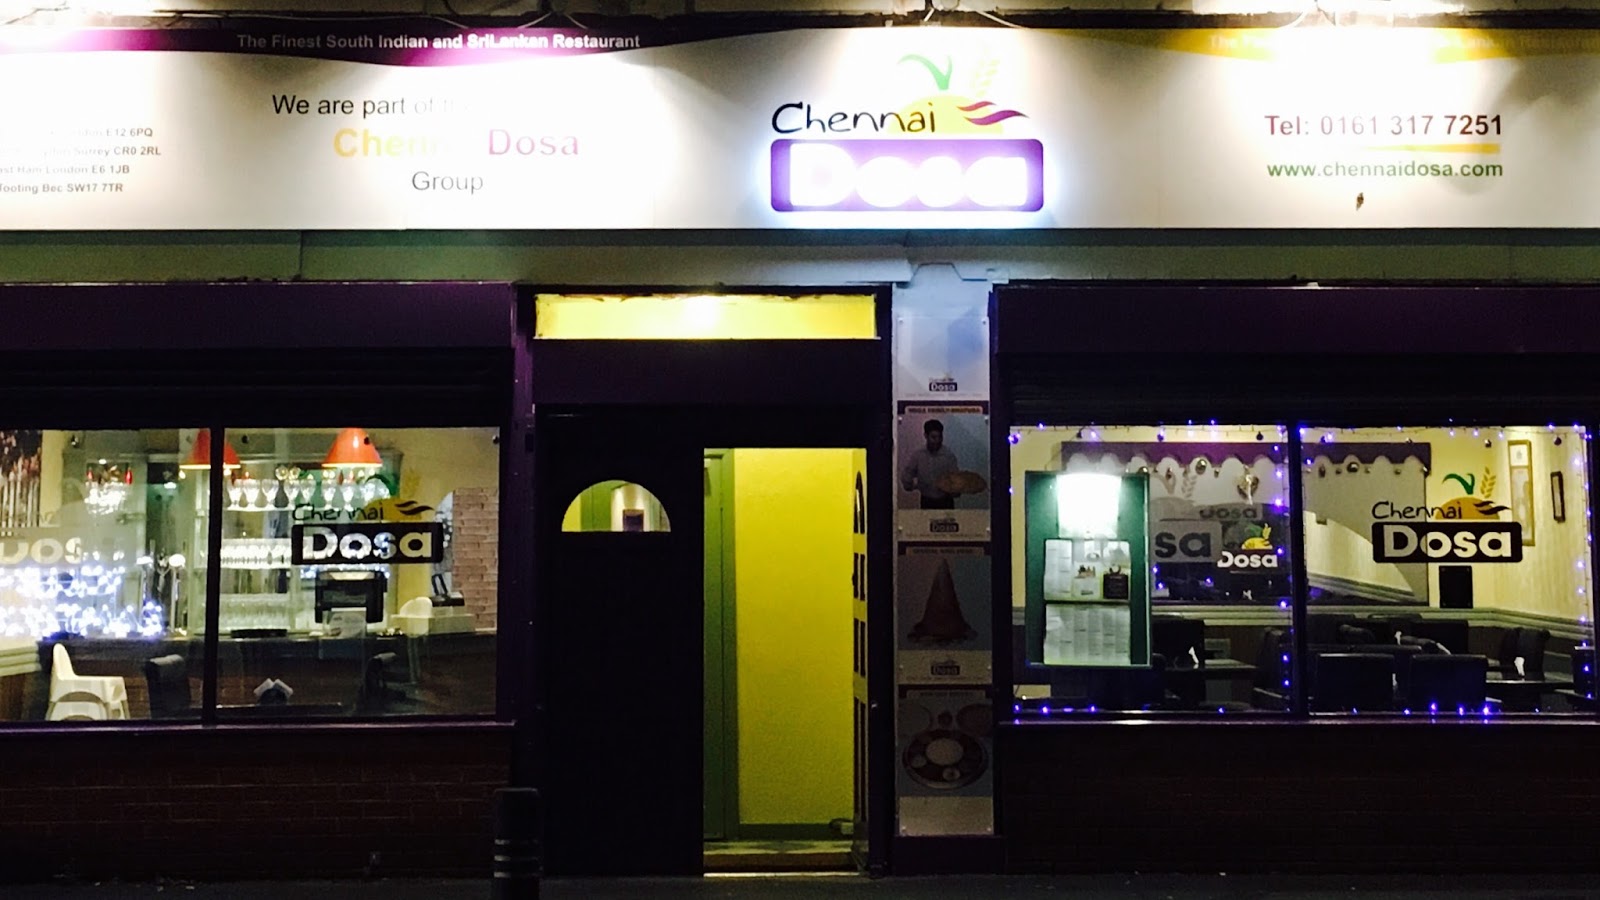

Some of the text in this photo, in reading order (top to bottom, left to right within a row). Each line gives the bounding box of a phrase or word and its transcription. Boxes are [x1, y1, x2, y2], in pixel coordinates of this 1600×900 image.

[237, 34, 267, 48] The
[272, 34, 321, 48] Finest
[326, 34, 373, 48] South
[378, 35, 428, 48] Indian
[432, 34, 463, 48] and
[553, 34, 640, 48] Restaurant
[272, 94, 310, 114] We
[317, 99, 354, 114] are
[362, 97, 405, 119] part
[771, 101, 936, 134] Chennai
[1264, 114, 1502, 135] Tel: 0161 317 7251
[129, 127, 153, 138] 6PQ
[140, 146, 161, 156] 2RL
[488, 129, 579, 156] Dosa
[46, 165, 88, 174] London
[91, 165, 106, 174] E6
[109, 165, 130, 174] 1JB
[789, 142, 1028, 208] Dosa
[1266, 160, 1504, 177] www.chennaidosa.com
[42, 183, 63, 192] Bec
[66, 183, 98, 192] SW17
[101, 183, 124, 192] 7TR
[411, 170, 483, 195] Group
[931, 383, 956, 391] Dosa
[292, 501, 384, 521] Chennai
[1371, 500, 1463, 519] Chennai
[302, 526, 432, 560] Dosa
[1383, 524, 1512, 558] Dosa
[1217, 551, 1278, 568] Dosa
